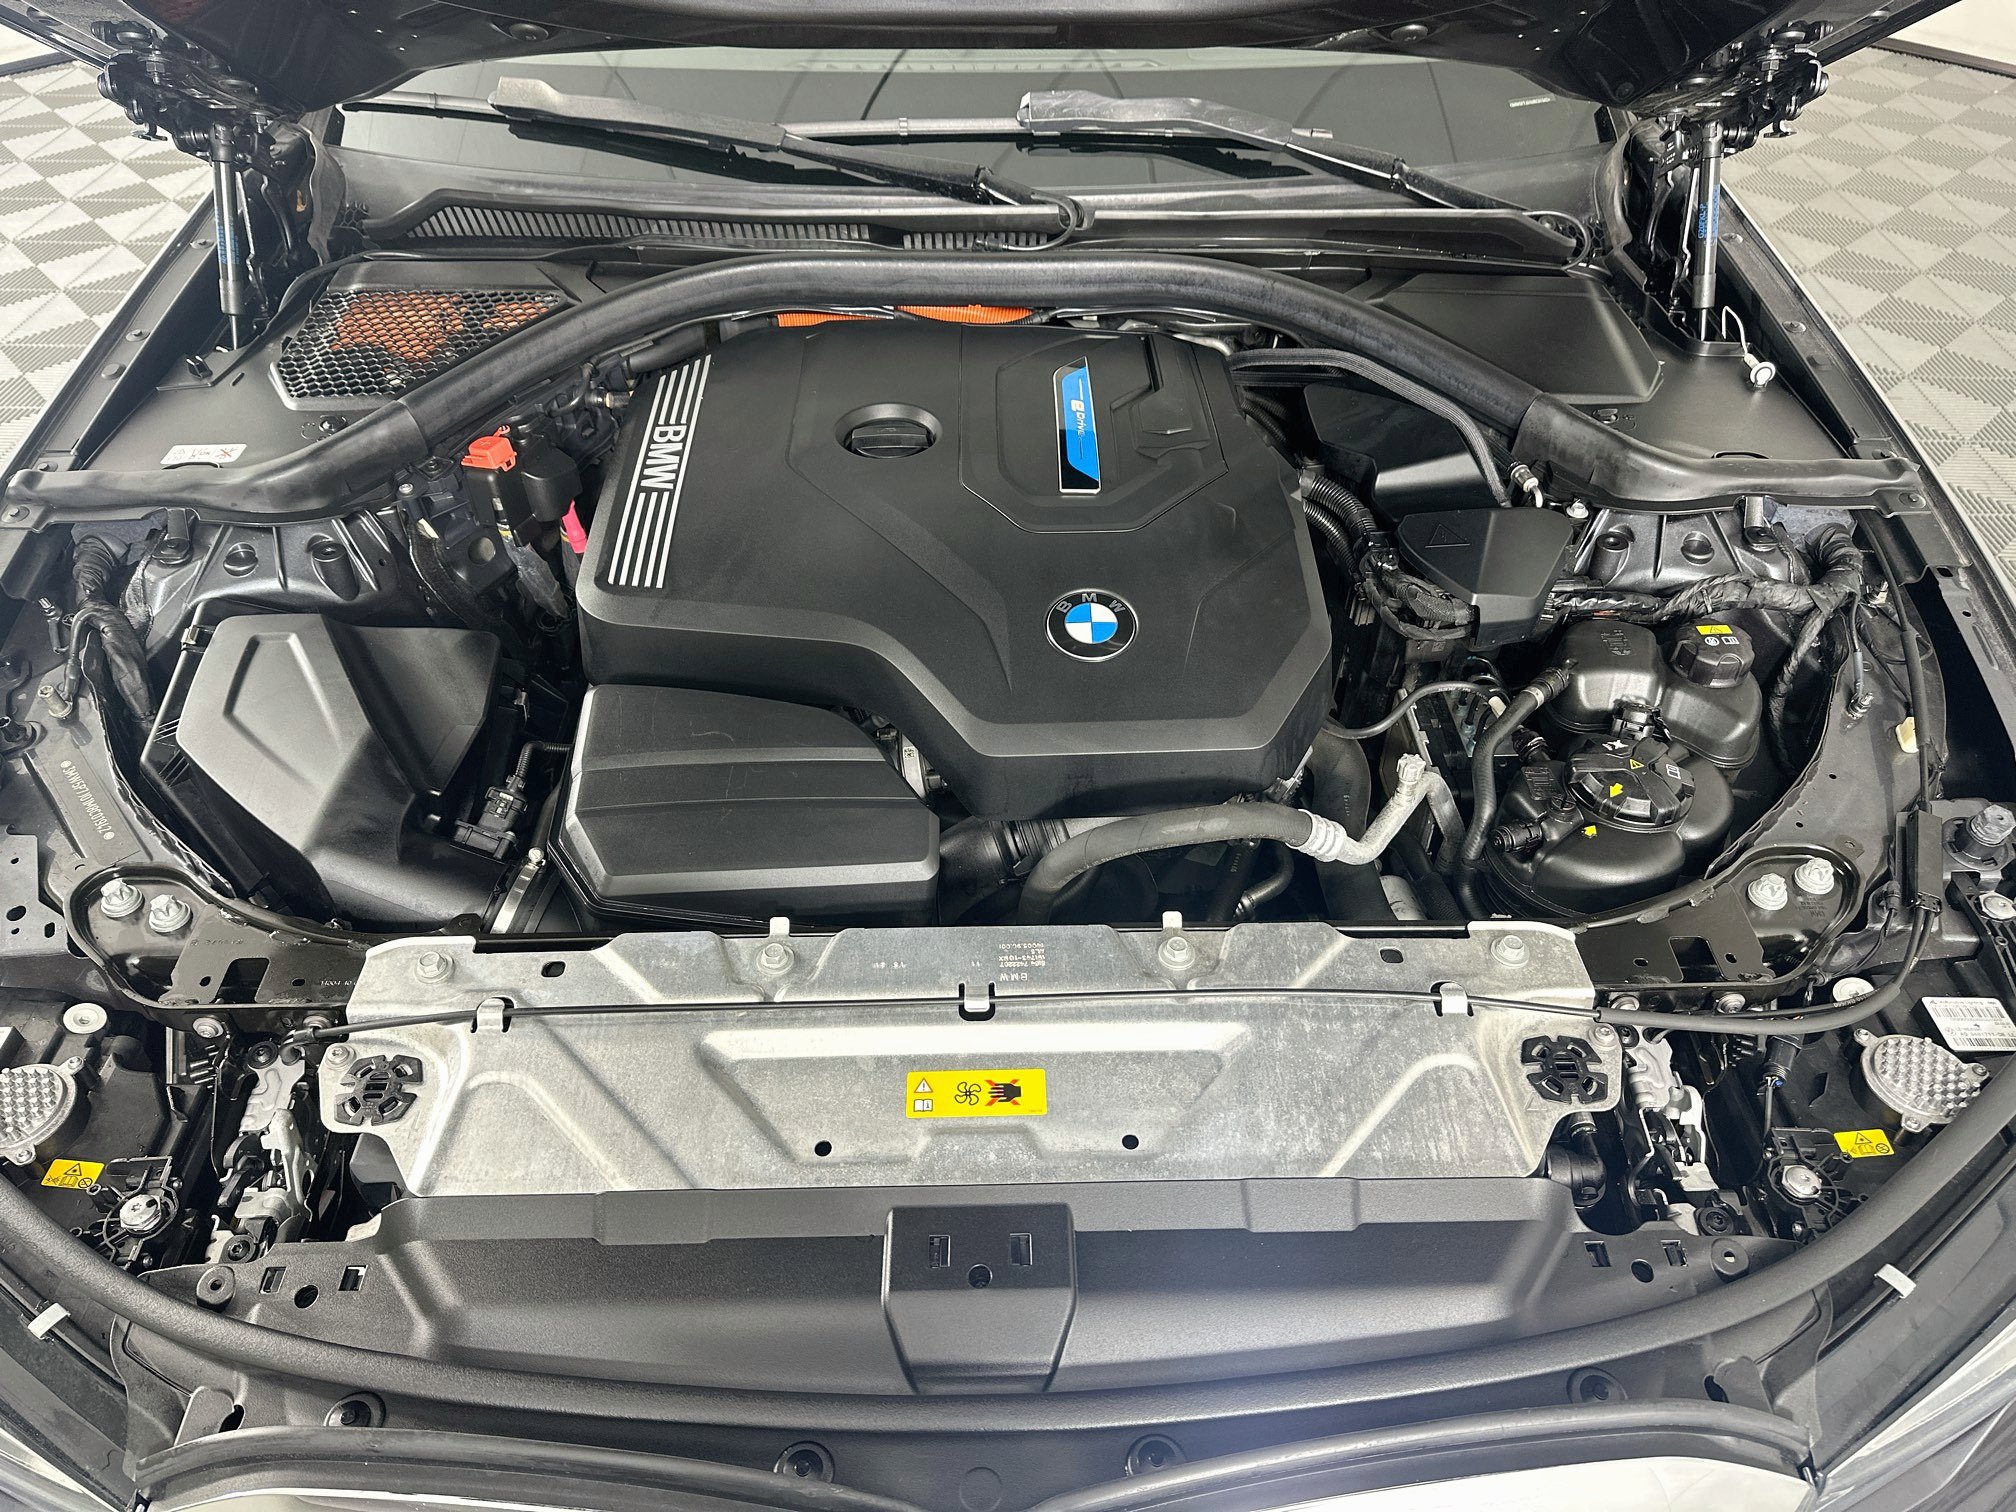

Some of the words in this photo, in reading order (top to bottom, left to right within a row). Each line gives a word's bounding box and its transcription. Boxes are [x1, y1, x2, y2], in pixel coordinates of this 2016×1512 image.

[640, 424, 687, 490] BMW
[1055, 593, 1126, 614] BMW
[999, 972, 1028, 982] BMW
